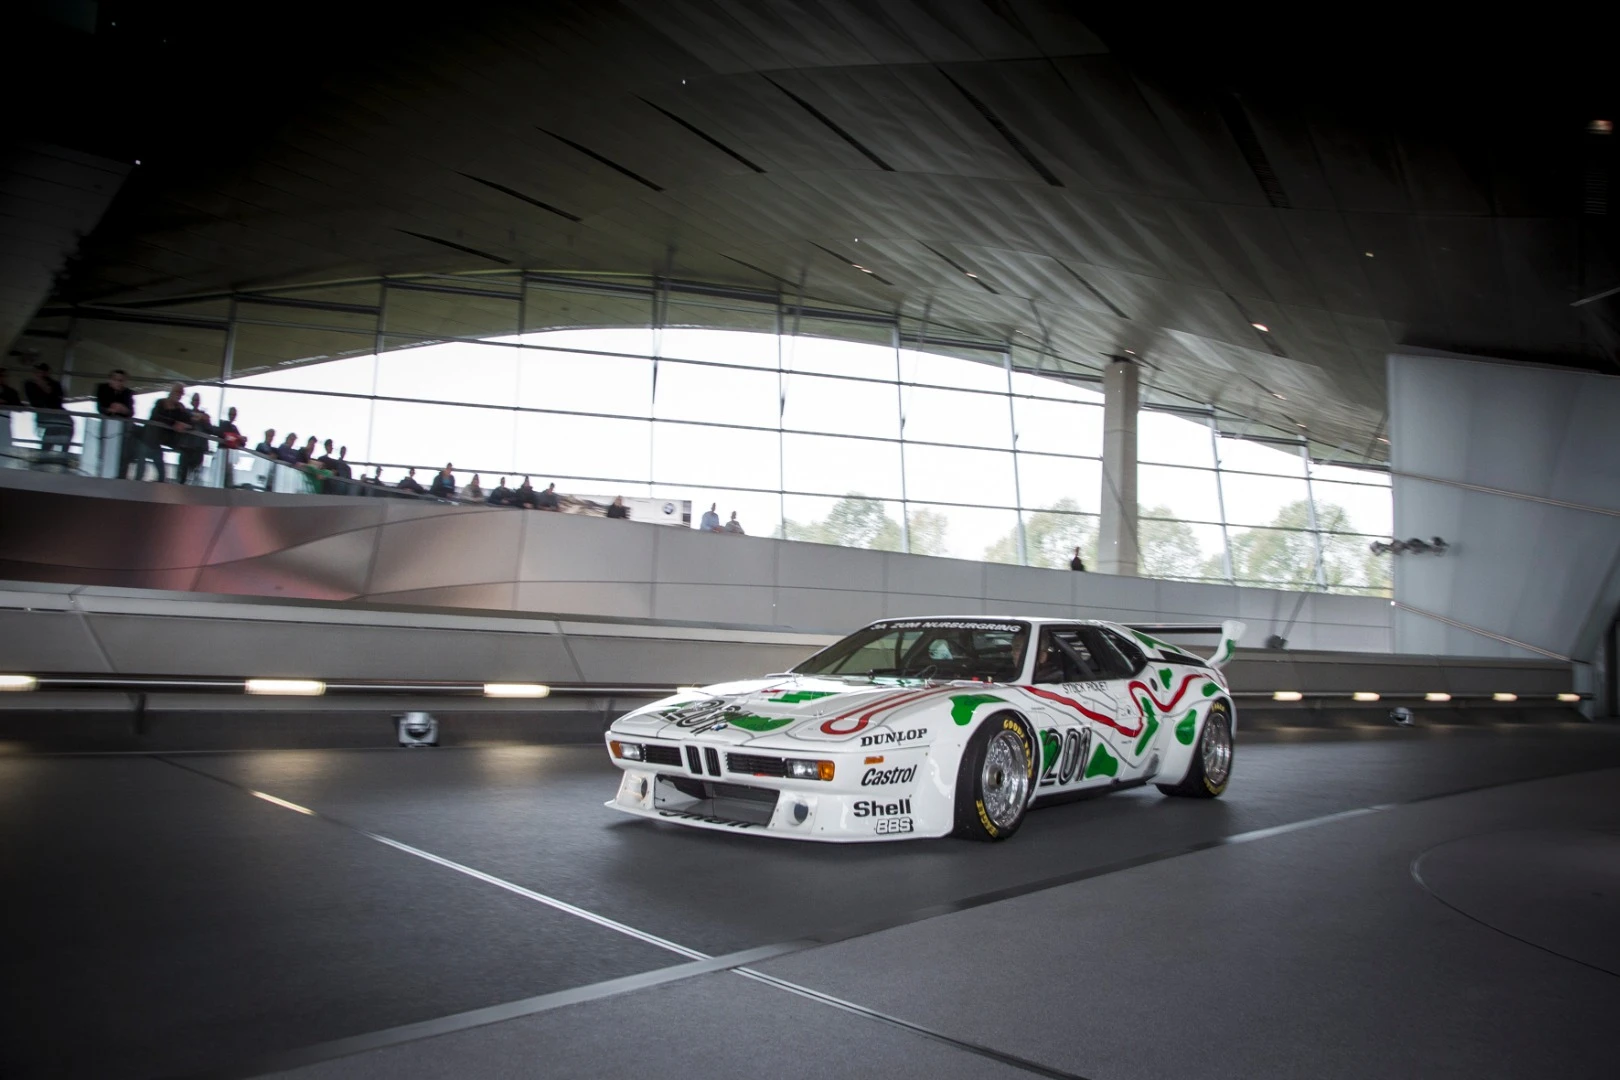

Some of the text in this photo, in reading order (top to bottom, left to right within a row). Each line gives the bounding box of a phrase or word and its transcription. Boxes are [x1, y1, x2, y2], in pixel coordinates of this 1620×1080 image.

[890, 622, 921, 631] ZUM
[861, 728, 927, 747] DUNLOP
[1039, 726, 1092, 787] 201
[861, 764, 917, 786] Castrol
[853, 798, 912, 817] Shell
[876, 816, 914, 834] BBS
